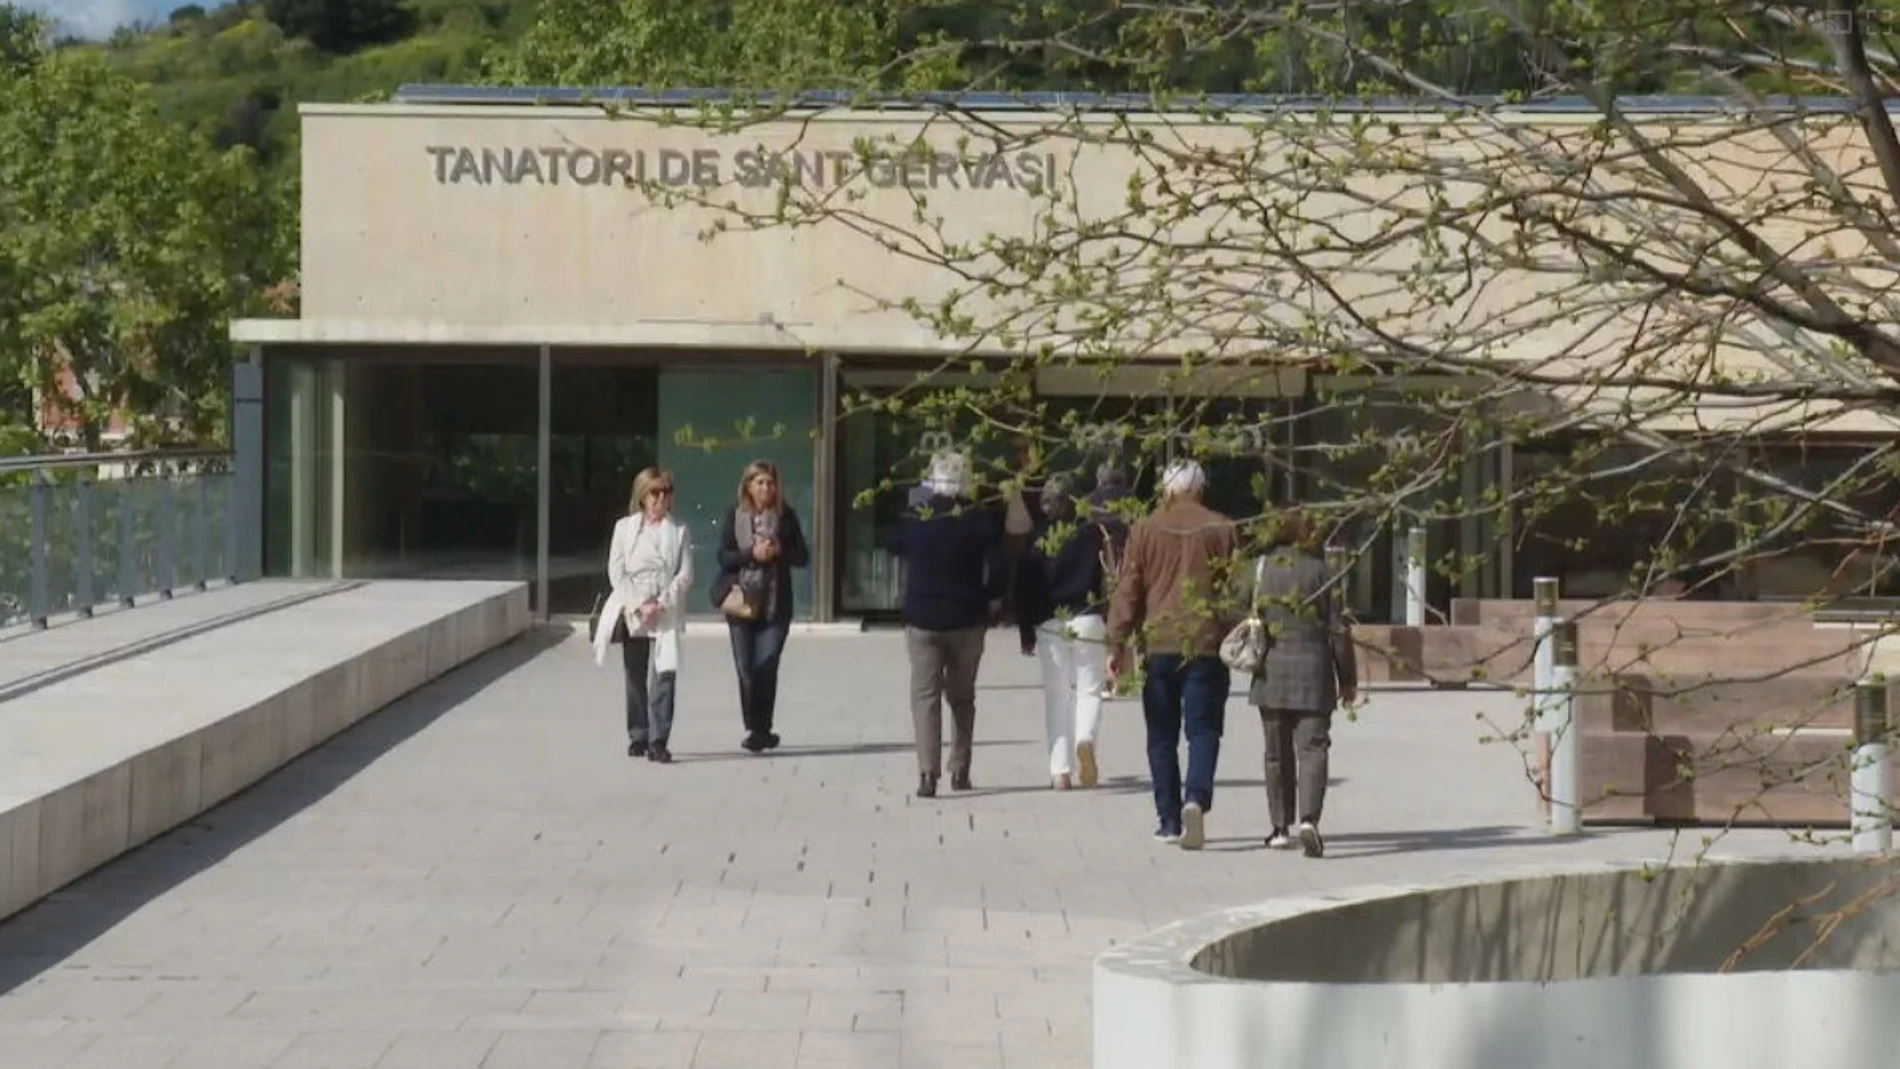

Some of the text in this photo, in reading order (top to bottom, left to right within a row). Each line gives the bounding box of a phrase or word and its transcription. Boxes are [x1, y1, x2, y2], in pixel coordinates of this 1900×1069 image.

[426, 146, 1055, 189] TANATORI DE SANT GERVASI
